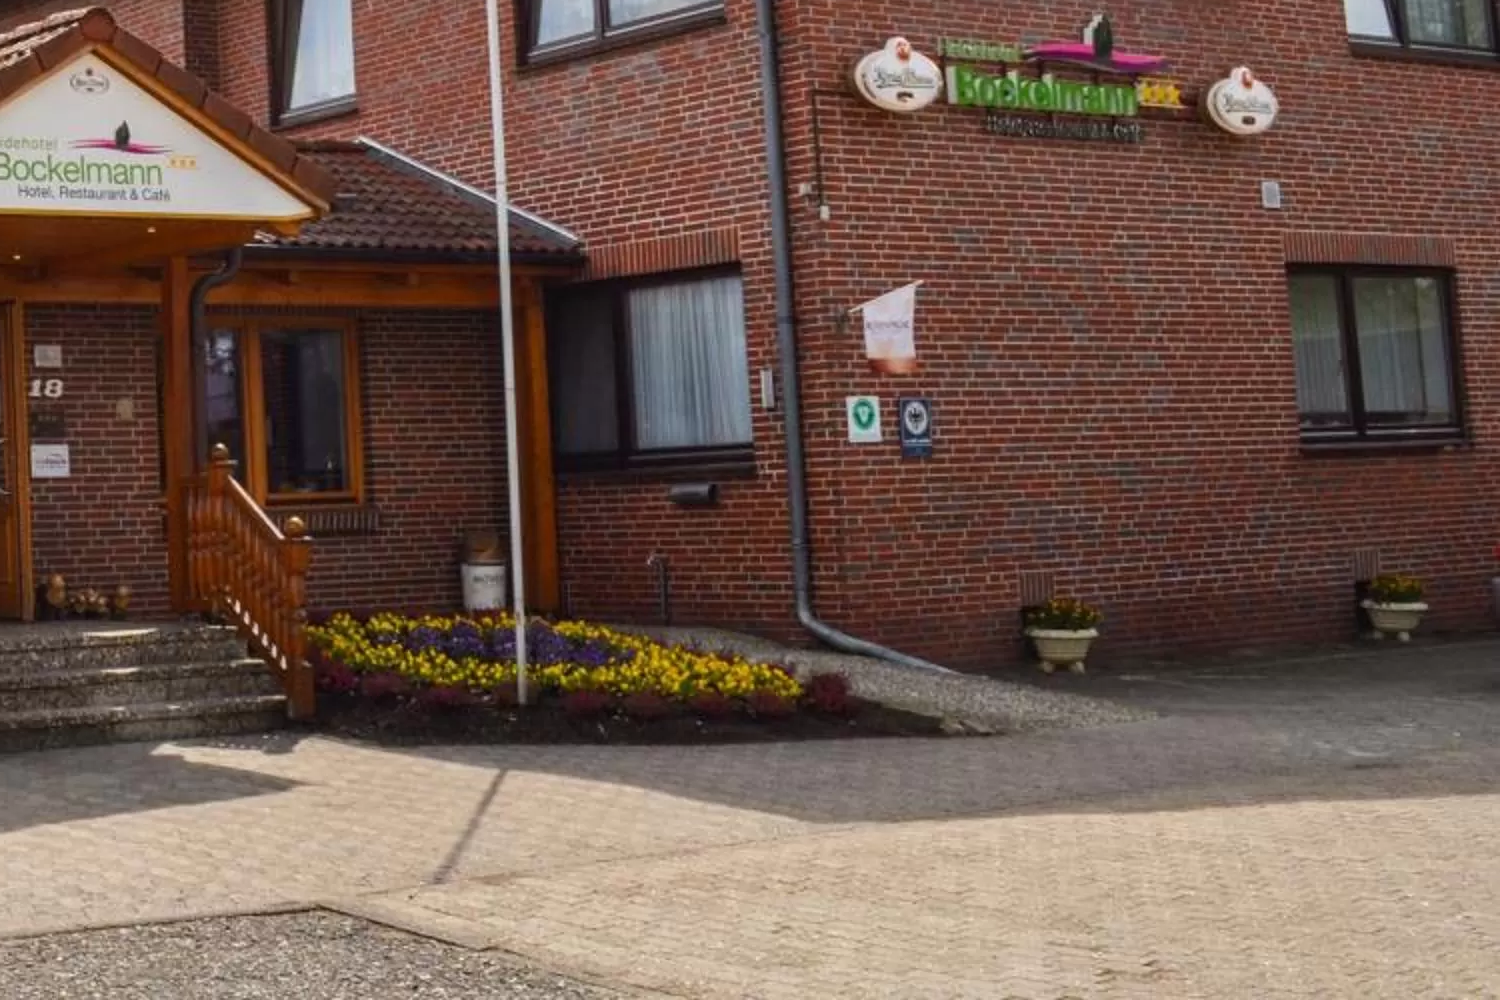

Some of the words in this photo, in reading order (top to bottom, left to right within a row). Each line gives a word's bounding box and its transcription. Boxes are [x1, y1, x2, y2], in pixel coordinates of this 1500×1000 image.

[18, 184, 54, 199] Hotel,
[59, 185, 127, 200] Restaurant
[28, 379, 64, 398] 18
